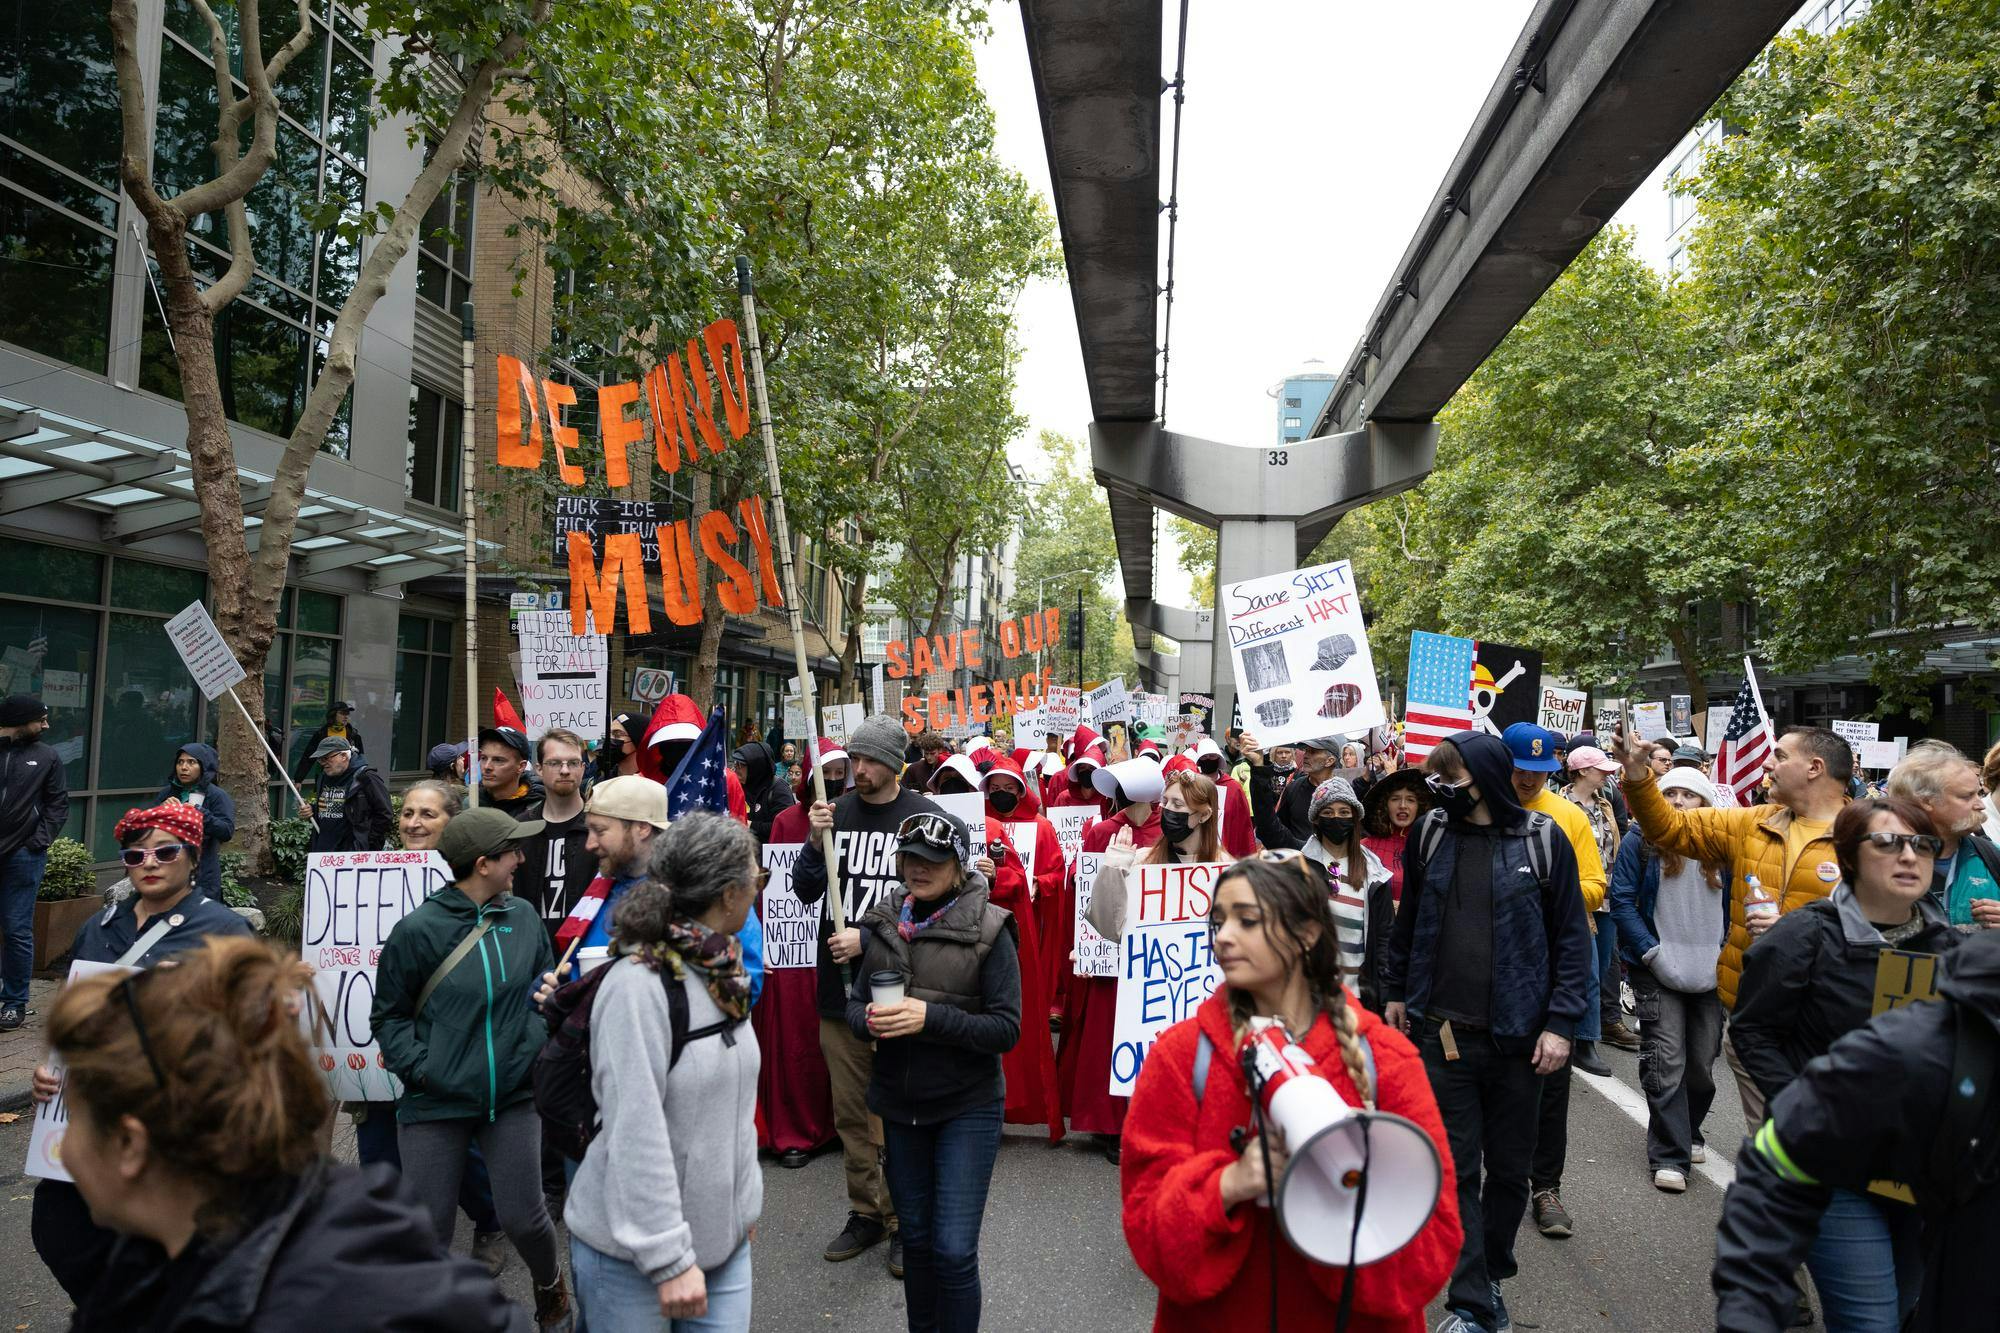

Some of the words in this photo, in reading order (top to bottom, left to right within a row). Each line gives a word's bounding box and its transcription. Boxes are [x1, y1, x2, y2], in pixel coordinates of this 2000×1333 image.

[497, 319, 750, 487] DEFUND
[1269, 451, 1288, 466] 33
[556, 498, 600, 515] FUCK
[620, 501, 656, 518] ICE
[1232, 585, 1290, 616] Same
[1293, 565, 1347, 600] SHIT
[1229, 615, 1304, 645] Different
[1306, 593, 1351, 623] HAT
[533, 636, 597, 654] JUSTICE
[886, 628, 982, 679] SAVE
[1000, 607, 1060, 659] OUR
[536, 656, 561, 672] FOR
[567, 653, 601, 671] ALL
[524, 686, 544, 699] NO
[548, 684, 603, 700] JUSTICE
[1050, 687, 1060, 695] NO
[1062, 689, 1081, 698] KINGS
[1048, 706, 1077, 715] AMERICA
[1544, 690, 1585, 714] PREVENT
[525, 714, 544, 727] NO
[550, 712, 598, 728] PEACE
[824, 711, 837, 721] WE
[1020, 719, 1031, 727] WE
[1541, 709, 1579, 732] TRUTH
[829, 724, 842, 732] THE
[320, 855, 345, 867] LOVE
[351, 854, 371, 865] THY
[834, 830, 900, 876] FUCK
[768, 899, 818, 919] BECOME
[320, 947, 360, 968] HATE
[768, 943, 812, 966] UNTIL
[1079, 942, 1090, 957] to
[1095, 941, 1112, 957] die
[1128, 933, 1183, 981] HAS
[1079, 958, 1114, 975] White
